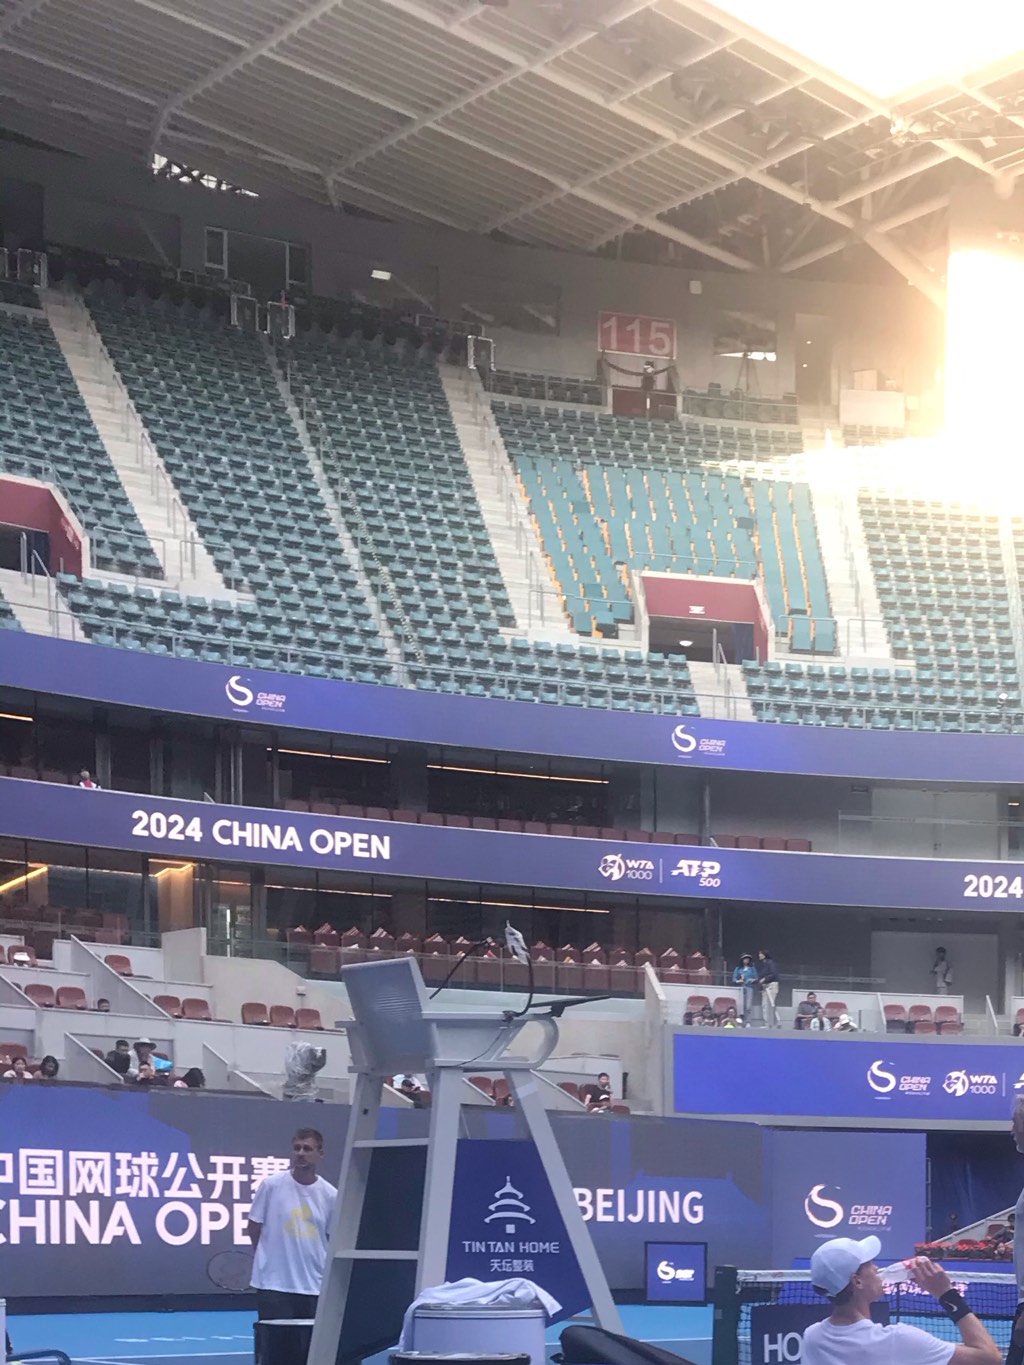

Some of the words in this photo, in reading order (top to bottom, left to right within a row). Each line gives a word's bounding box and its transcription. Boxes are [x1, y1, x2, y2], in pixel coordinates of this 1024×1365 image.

[602, 316, 672, 355] 115
[131, 810, 203, 842] 2024
[212, 819, 303, 852] CHINA
[309, 828, 391, 860] OPEN
[626, 859, 654, 870] WTA
[670, 859, 720, 877] ATP
[626, 869, 652, 880] 1000
[699, 877, 721, 888] 500
[963, 874, 1024, 899] 2024
[969, 1074, 998, 1084] WTA
[970, 1085, 996, 1094] 1000
[573, 1188, 704, 1224] BEIJING
[850, 1204, 893, 1216] CHINA
[0, 1199, 142, 1245] HINA
[155, 1201, 253, 1246] OPE
[848, 1214, 888, 1225] OPEN
[518, 1241, 560, 1253] HOME
